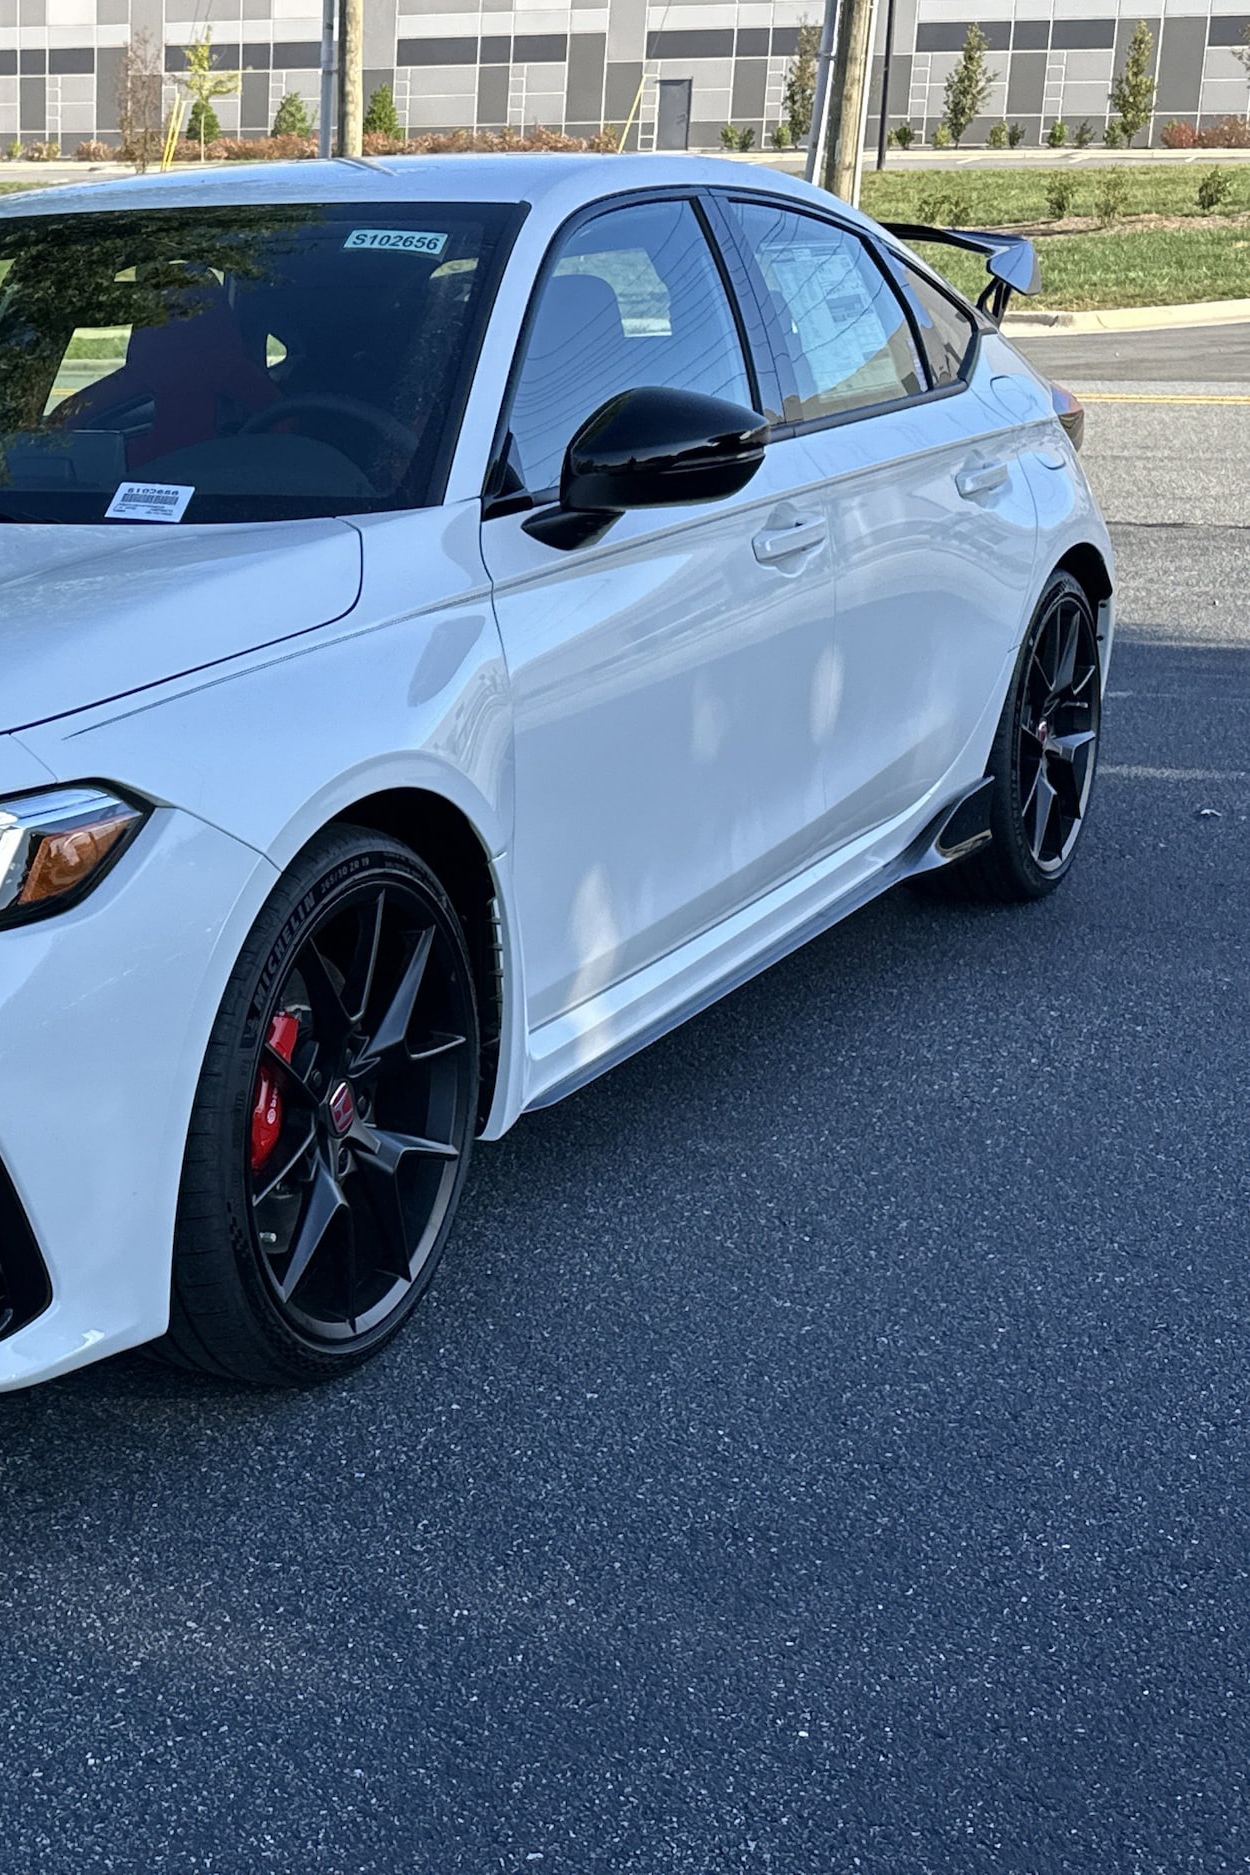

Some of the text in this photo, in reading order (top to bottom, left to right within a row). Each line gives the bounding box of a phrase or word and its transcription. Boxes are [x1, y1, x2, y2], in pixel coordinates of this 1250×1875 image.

[352, 233, 439, 251] S102656
[253, 891, 316, 1011] MICHELIN
[320, 865, 348, 894] 265/30
